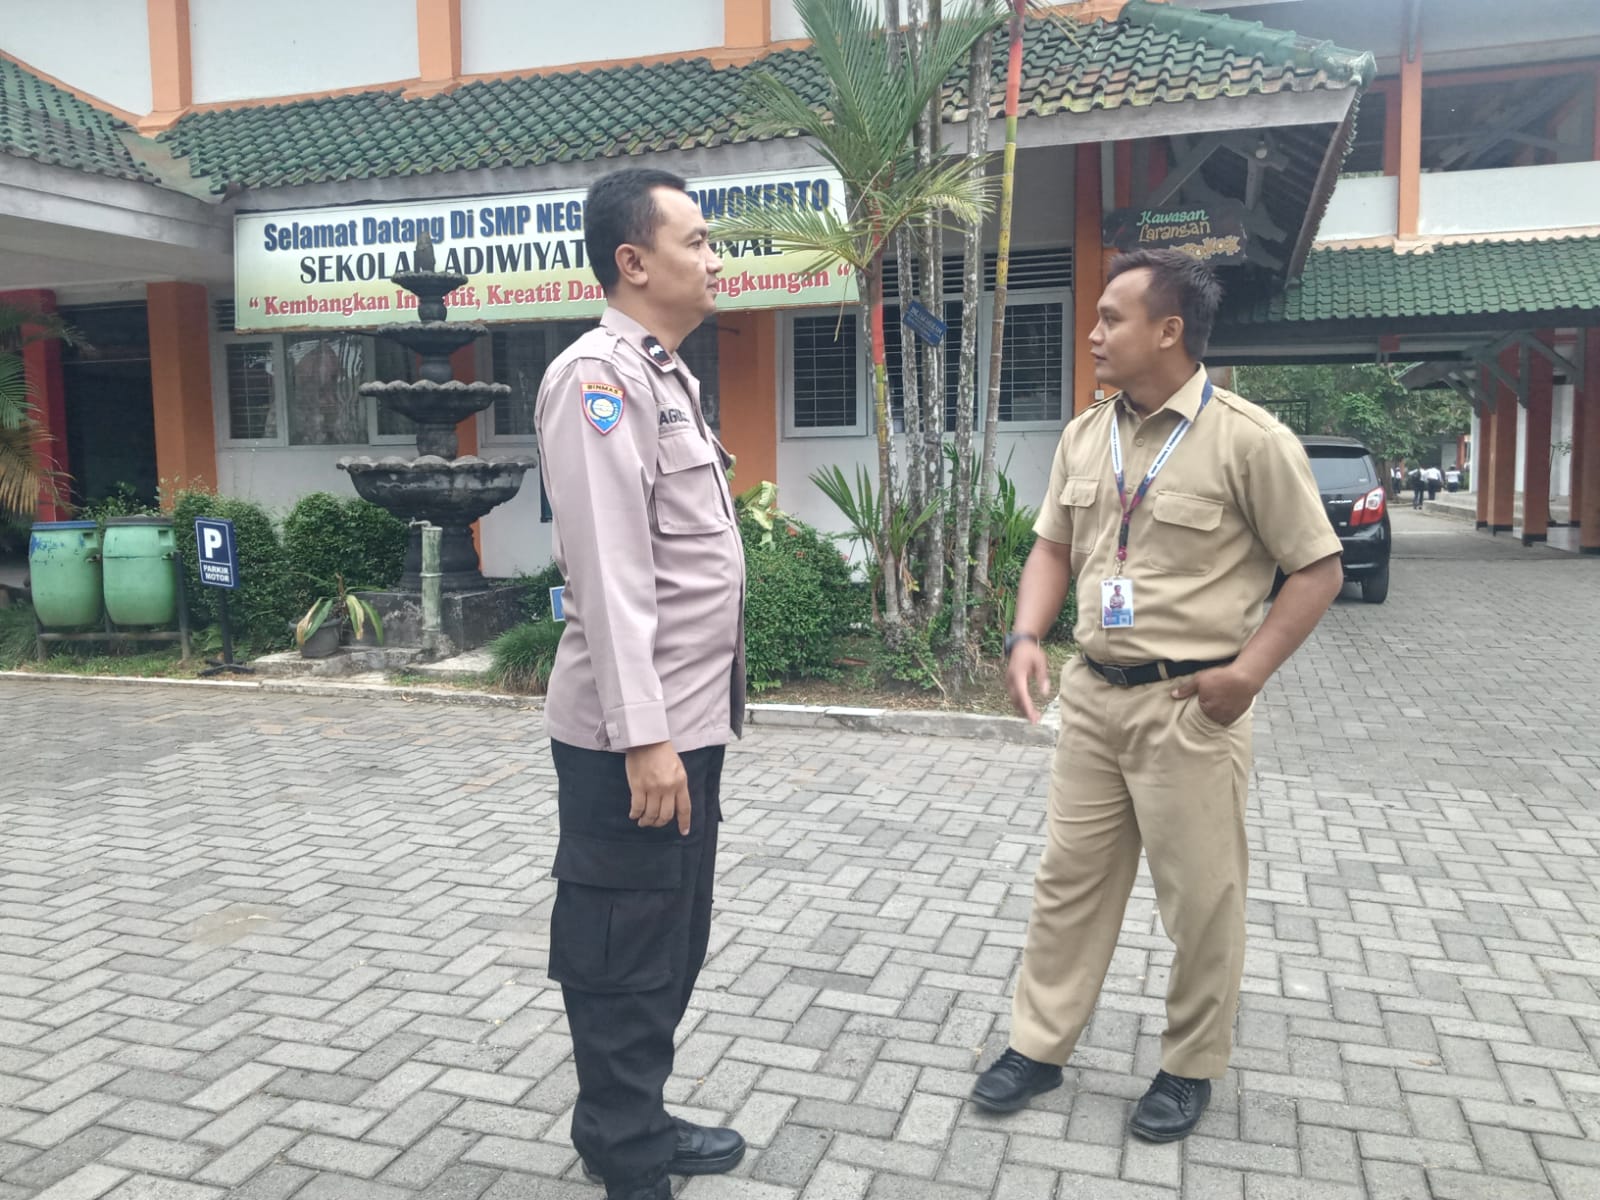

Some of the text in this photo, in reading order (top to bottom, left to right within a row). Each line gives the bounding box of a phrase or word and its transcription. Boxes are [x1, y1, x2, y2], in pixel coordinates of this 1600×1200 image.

[264, 220, 358, 251] Selamat
[362, 216, 445, 245] Datang
[450, 209, 475, 239] Di
[480, 204, 531, 238] SMP
[536, 200, 588, 234] NEG
[1136, 208, 1209, 226] Kawasan
[445, 239, 592, 275] ADIWIYAT
[264, 291, 390, 315] Kembangkan
[487, 281, 561, 305] Kreatif
[203, 527, 222, 559] P
[205, 572, 229, 582] MOTOR
